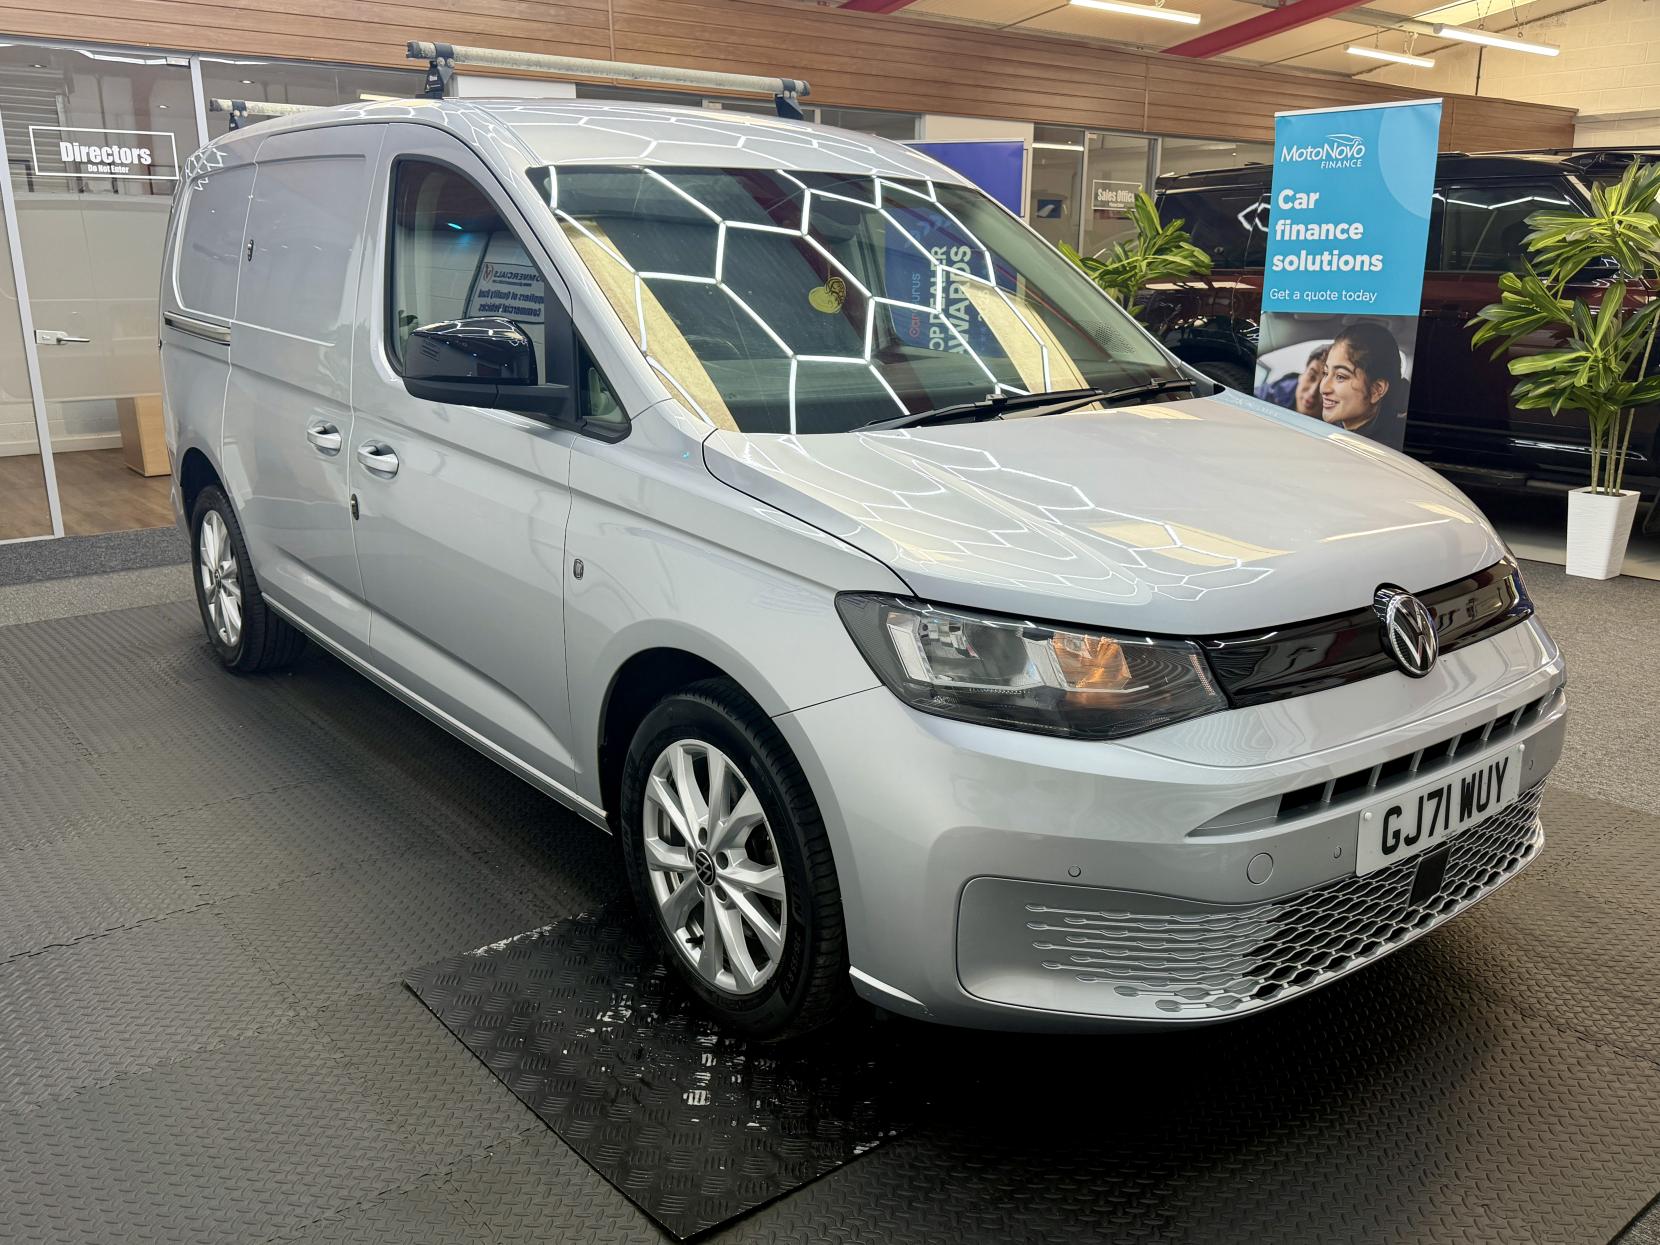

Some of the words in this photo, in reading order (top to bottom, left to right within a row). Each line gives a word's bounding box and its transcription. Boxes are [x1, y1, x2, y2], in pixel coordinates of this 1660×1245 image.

[60, 141, 152, 165] Directors
[1280, 139, 1365, 162] MotoNovo
[87, 164, 98, 172] Do
[98, 165, 111, 173] Not
[111, 165, 129, 174] Enter
[1320, 159, 1363, 169] FINANCE
[1097, 189, 1116, 201] Sales
[1278, 188, 1319, 210] Car
[1275, 219, 1364, 241] finance
[1272, 250, 1384, 272] solutions
[1269, 288, 1290, 300] Get
[1293, 291, 1300, 300] a
[1303, 289, 1339, 305] quote
[1342, 289, 1378, 304] today
[1381, 783, 1453, 856] GJ71
[1459, 756, 1509, 823] WUY
